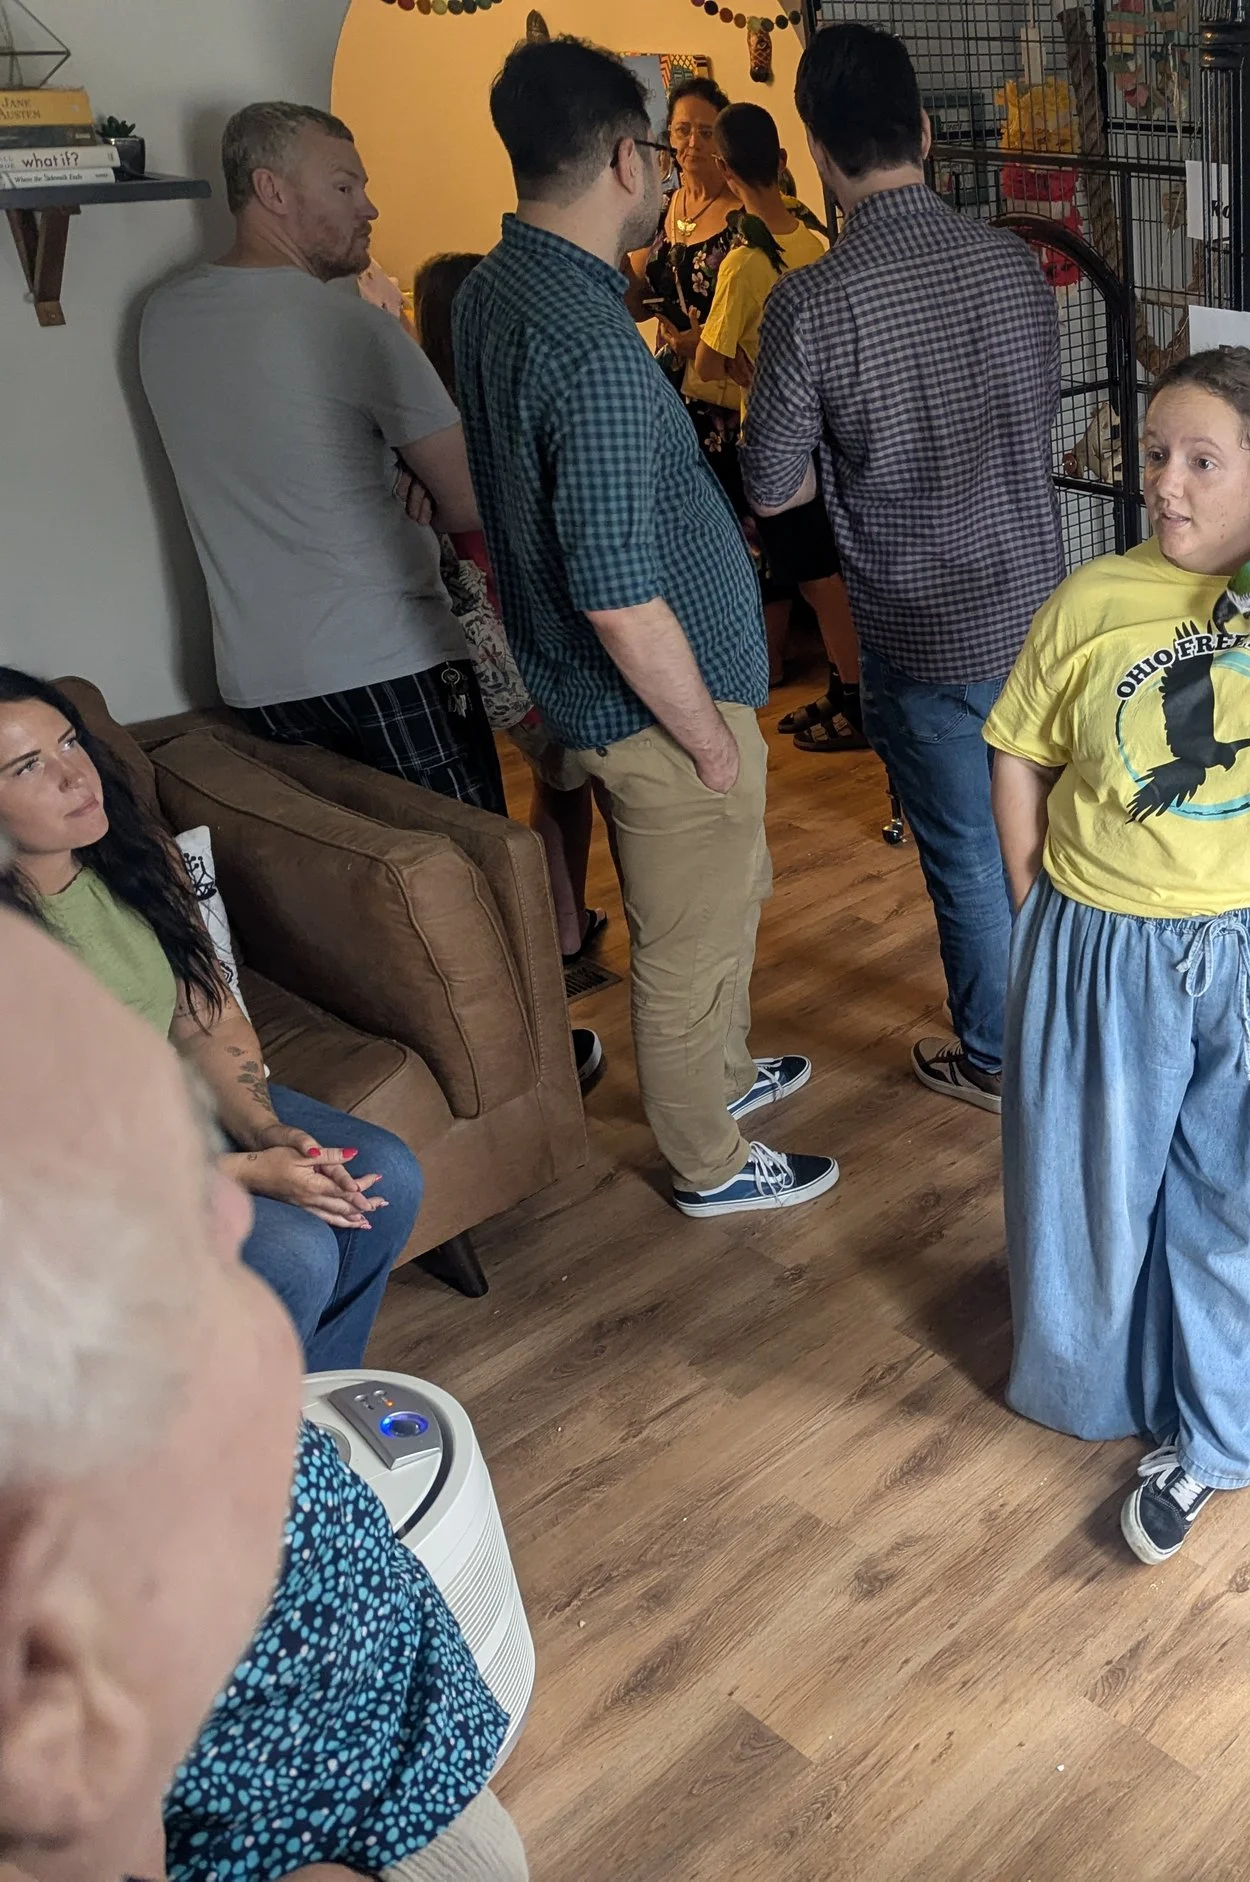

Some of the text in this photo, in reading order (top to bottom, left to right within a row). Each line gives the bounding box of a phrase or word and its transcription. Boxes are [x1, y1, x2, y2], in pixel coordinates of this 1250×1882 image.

[2, 97, 32, 108] JANE
[0, 107, 41, 120] AUSTEN
[22, 152, 58, 168] what
[60, 151, 79, 166] if?
[1115, 648, 1175, 700] OHIO
[1176, 632, 1250, 661] FREE
